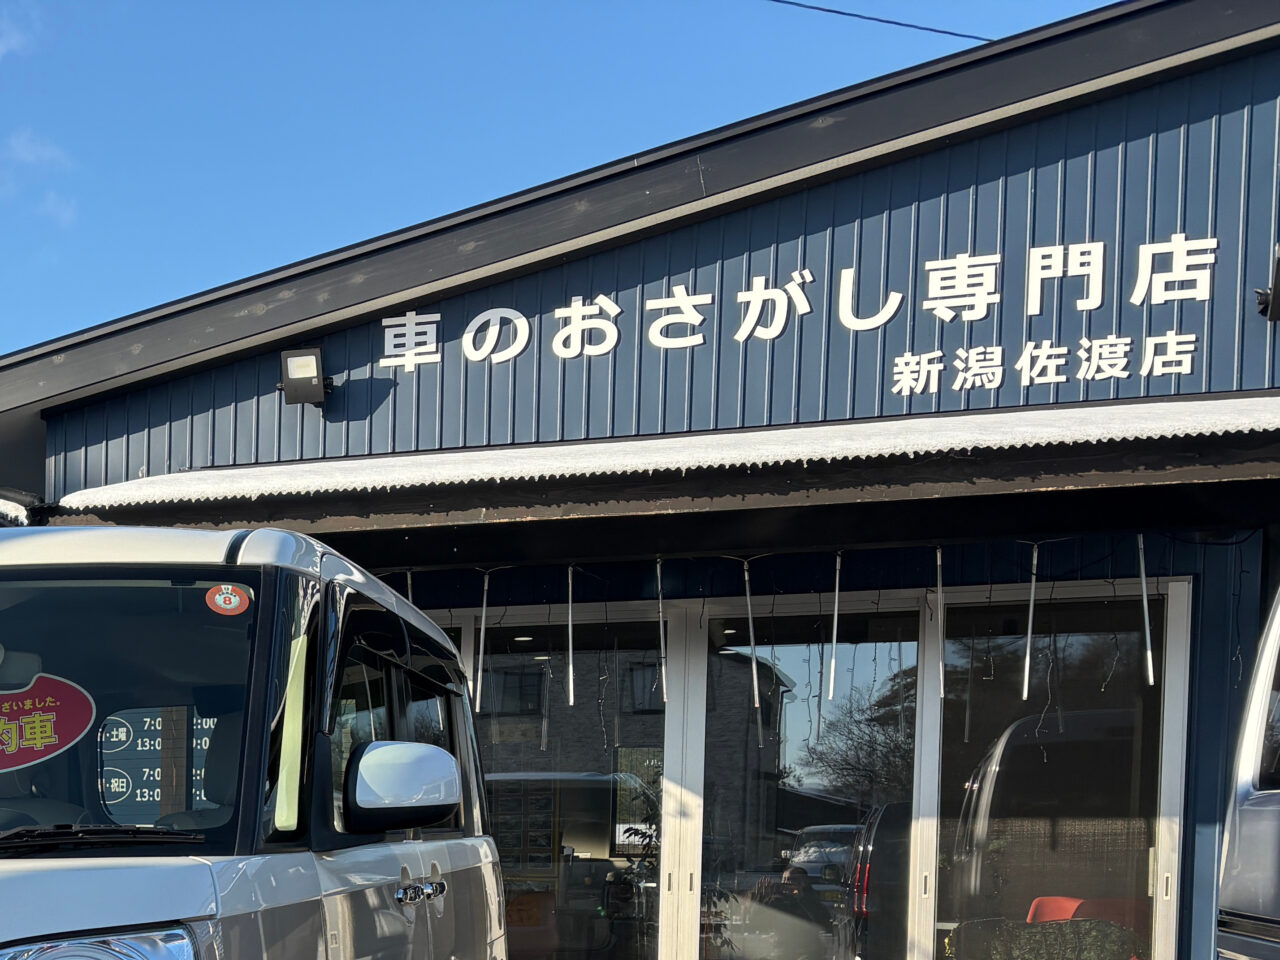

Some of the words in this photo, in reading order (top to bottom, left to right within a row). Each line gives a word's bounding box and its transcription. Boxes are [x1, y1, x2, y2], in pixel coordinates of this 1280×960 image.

[379, 233, 1219, 373] 車のおさがし専門店
[891, 330, 1199, 397] 新潟佐渡店
[143, 717, 162, 730] 7:0
[136, 738, 162, 750] 13:0
[142, 767, 161, 780] 7:0
[135, 788, 161, 801] 13:0
